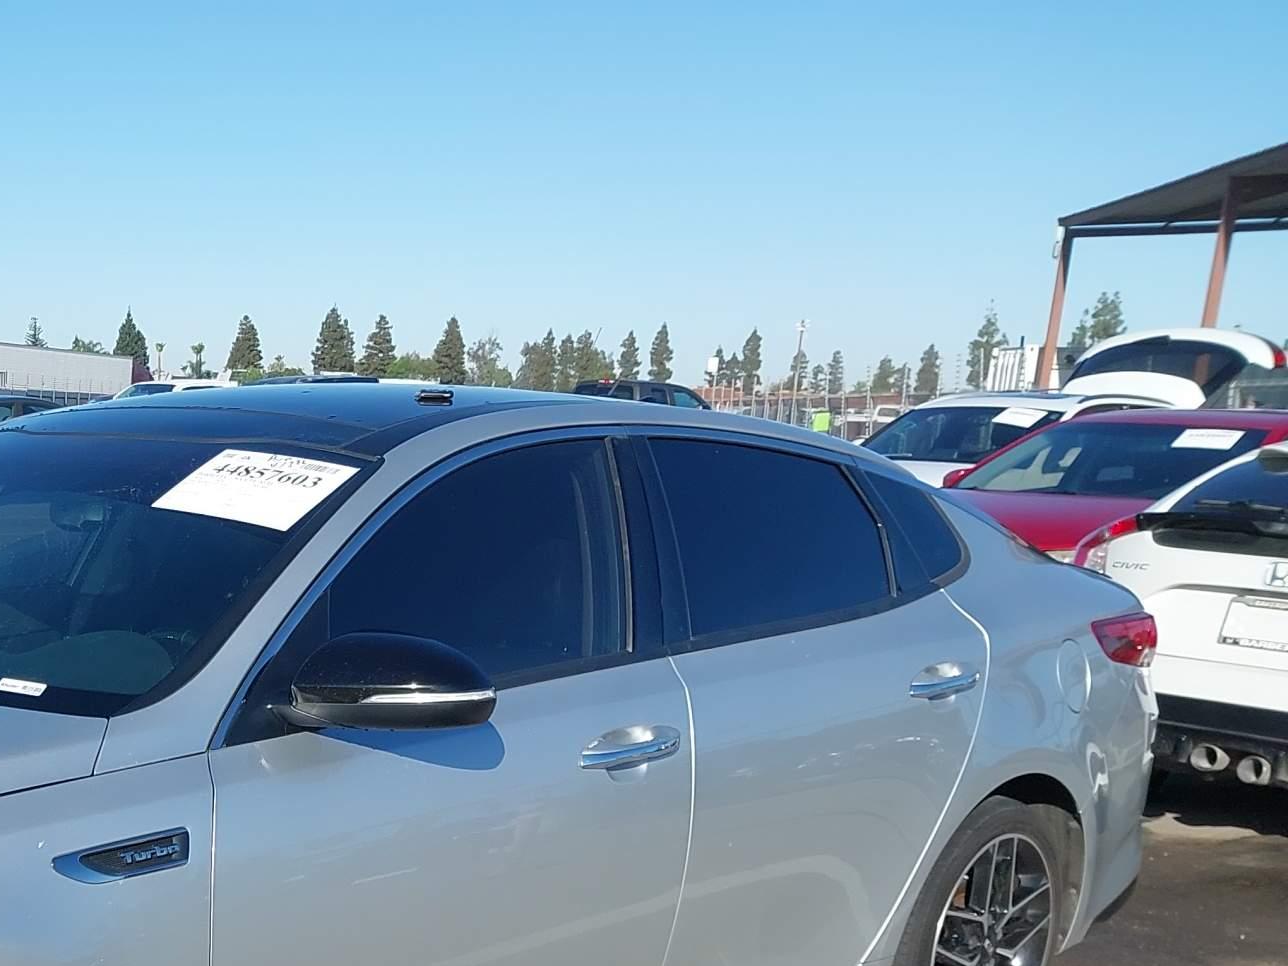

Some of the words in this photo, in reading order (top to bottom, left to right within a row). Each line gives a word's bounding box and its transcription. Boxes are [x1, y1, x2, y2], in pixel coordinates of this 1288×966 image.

[214, 463, 323, 488] 44857603
[1112, 561, 1151, 571] CIVIC
[120, 844, 181, 864] Turbo
